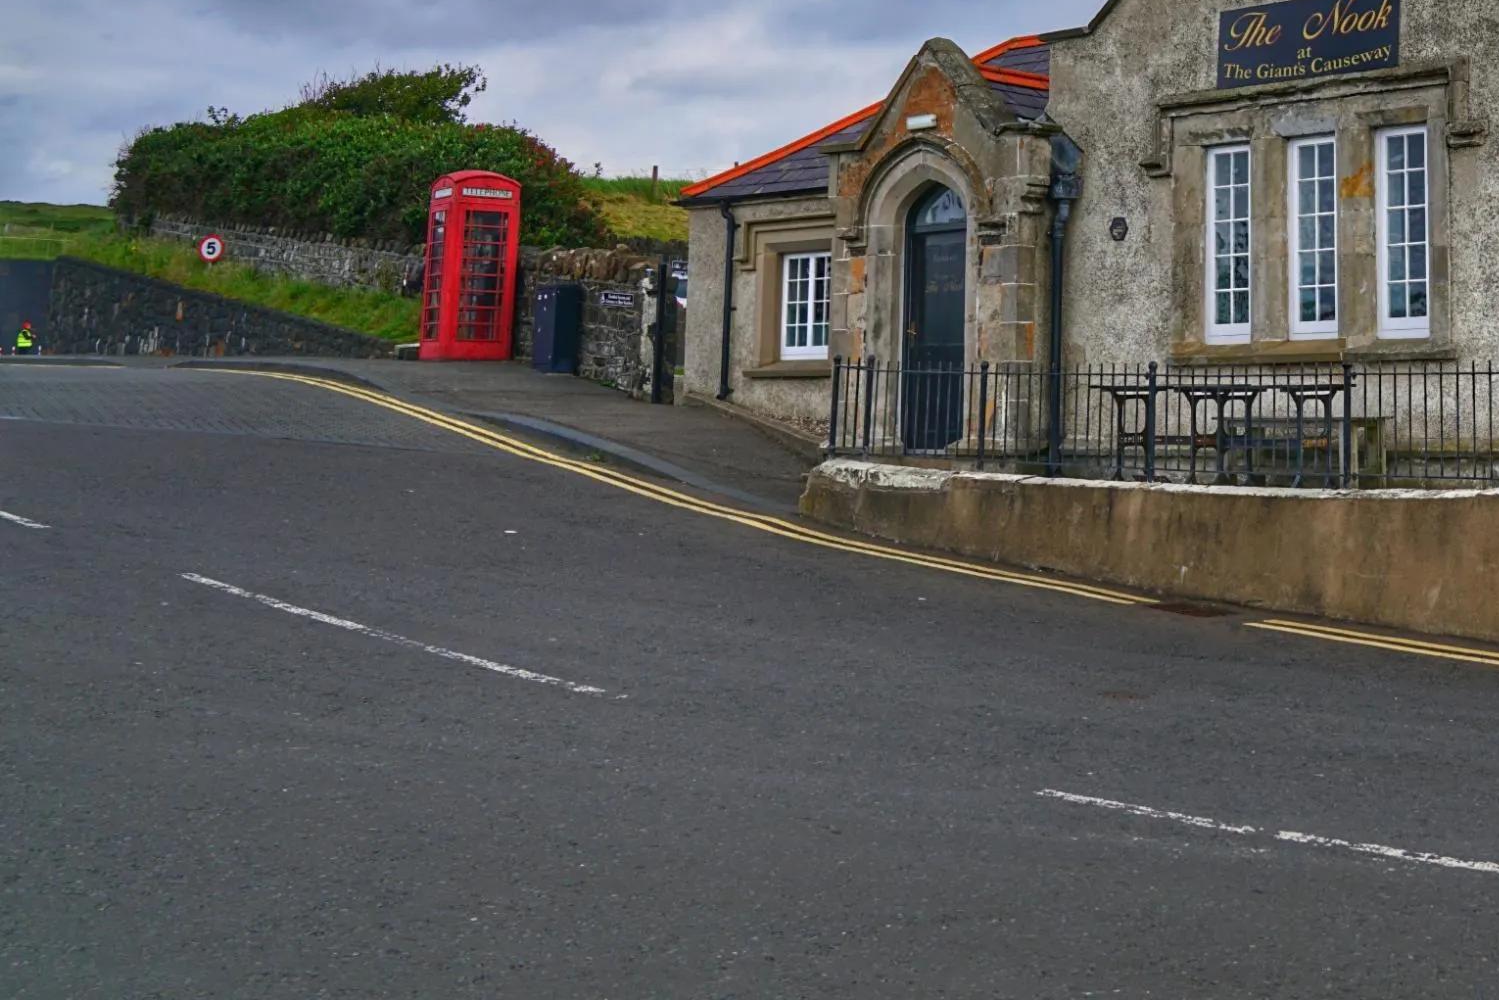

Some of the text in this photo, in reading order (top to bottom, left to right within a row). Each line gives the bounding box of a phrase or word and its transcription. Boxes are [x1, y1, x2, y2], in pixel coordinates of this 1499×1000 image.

[1224, 12, 1281, 51] The
[1297, 46, 1312, 60] at
[1223, 63, 1252, 80] The
[1311, 44, 1392, 73] Causeway
[465, 187, 511, 198] TELEPHONE
[207, 241, 216, 255] 5
